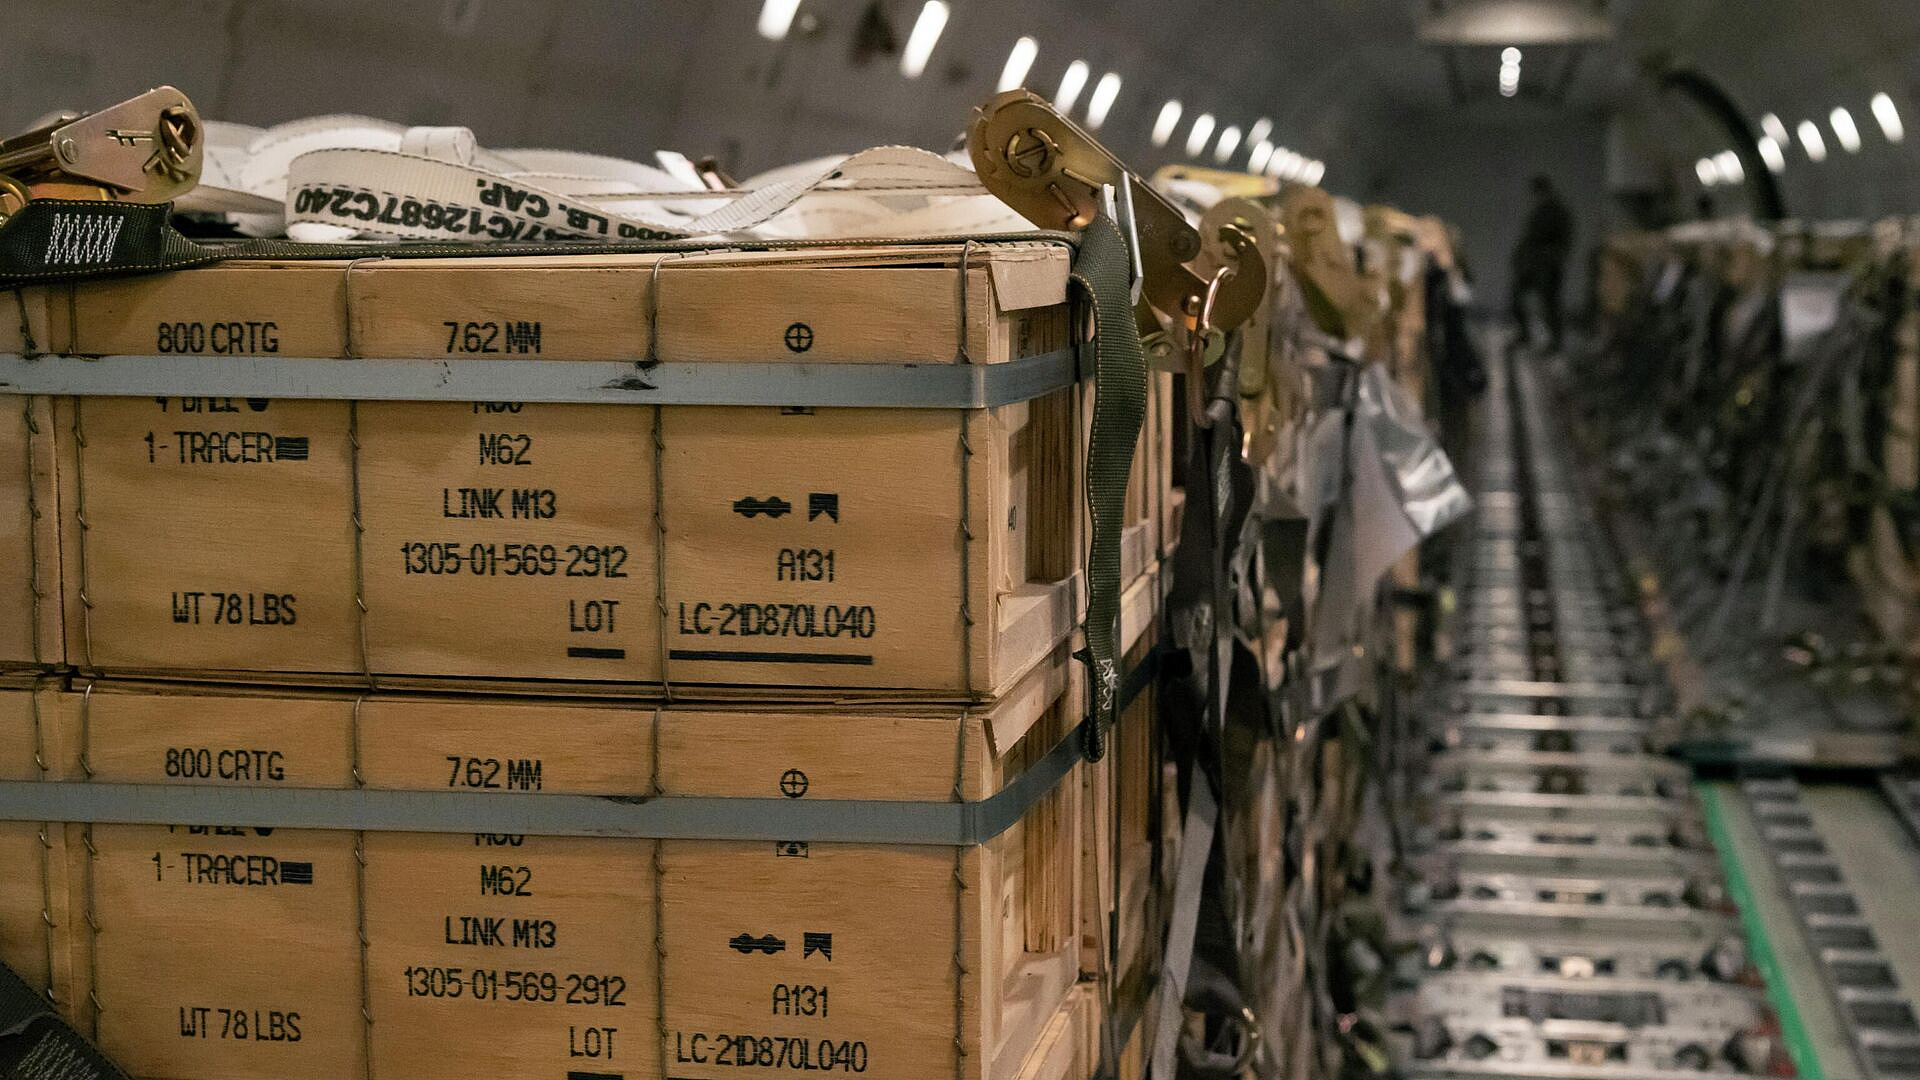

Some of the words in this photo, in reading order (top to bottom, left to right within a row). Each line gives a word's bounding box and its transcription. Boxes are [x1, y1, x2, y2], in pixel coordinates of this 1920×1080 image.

[294, 187, 576, 241] 47/C12687C240
[475, 178, 551, 219] CAP.
[558, 203, 609, 235] LB.
[157, 322, 205, 354] 800
[210, 321, 279, 355] CRTG
[443, 321, 500, 354] 7.62
[505, 321, 542, 354] MM
[172, 430, 274, 464] TRACER
[479, 433, 532, 466] M62
[443, 487, 505, 519] LINK
[511, 488, 557, 520] M13
[399, 542, 628, 579] 1305-01-569-2912
[777, 548, 835, 583] A131
[172, 591, 206, 625] WT
[210, 592, 243, 625] 78
[248, 593, 297, 626] LBS
[569, 599, 620, 634] LOT
[165, 748, 212, 779] 800
[217, 749, 285, 781] CRTG
[446, 756, 501, 789] 7.62
[507, 759, 542, 791] MM
[180, 852, 279, 886] TRACER
[480, 864, 533, 897] M62
[445, 915, 506, 947] LINK
[512, 919, 557, 949] M13
[404, 966, 626, 1007] 1305-01-569-2912
[772, 983, 828, 1018] A131
[179, 1006, 211, 1039] WT
[217, 1008, 249, 1040] 78
[254, 1010, 302, 1043] LBS
[569, 1025, 618, 1060] LOT
